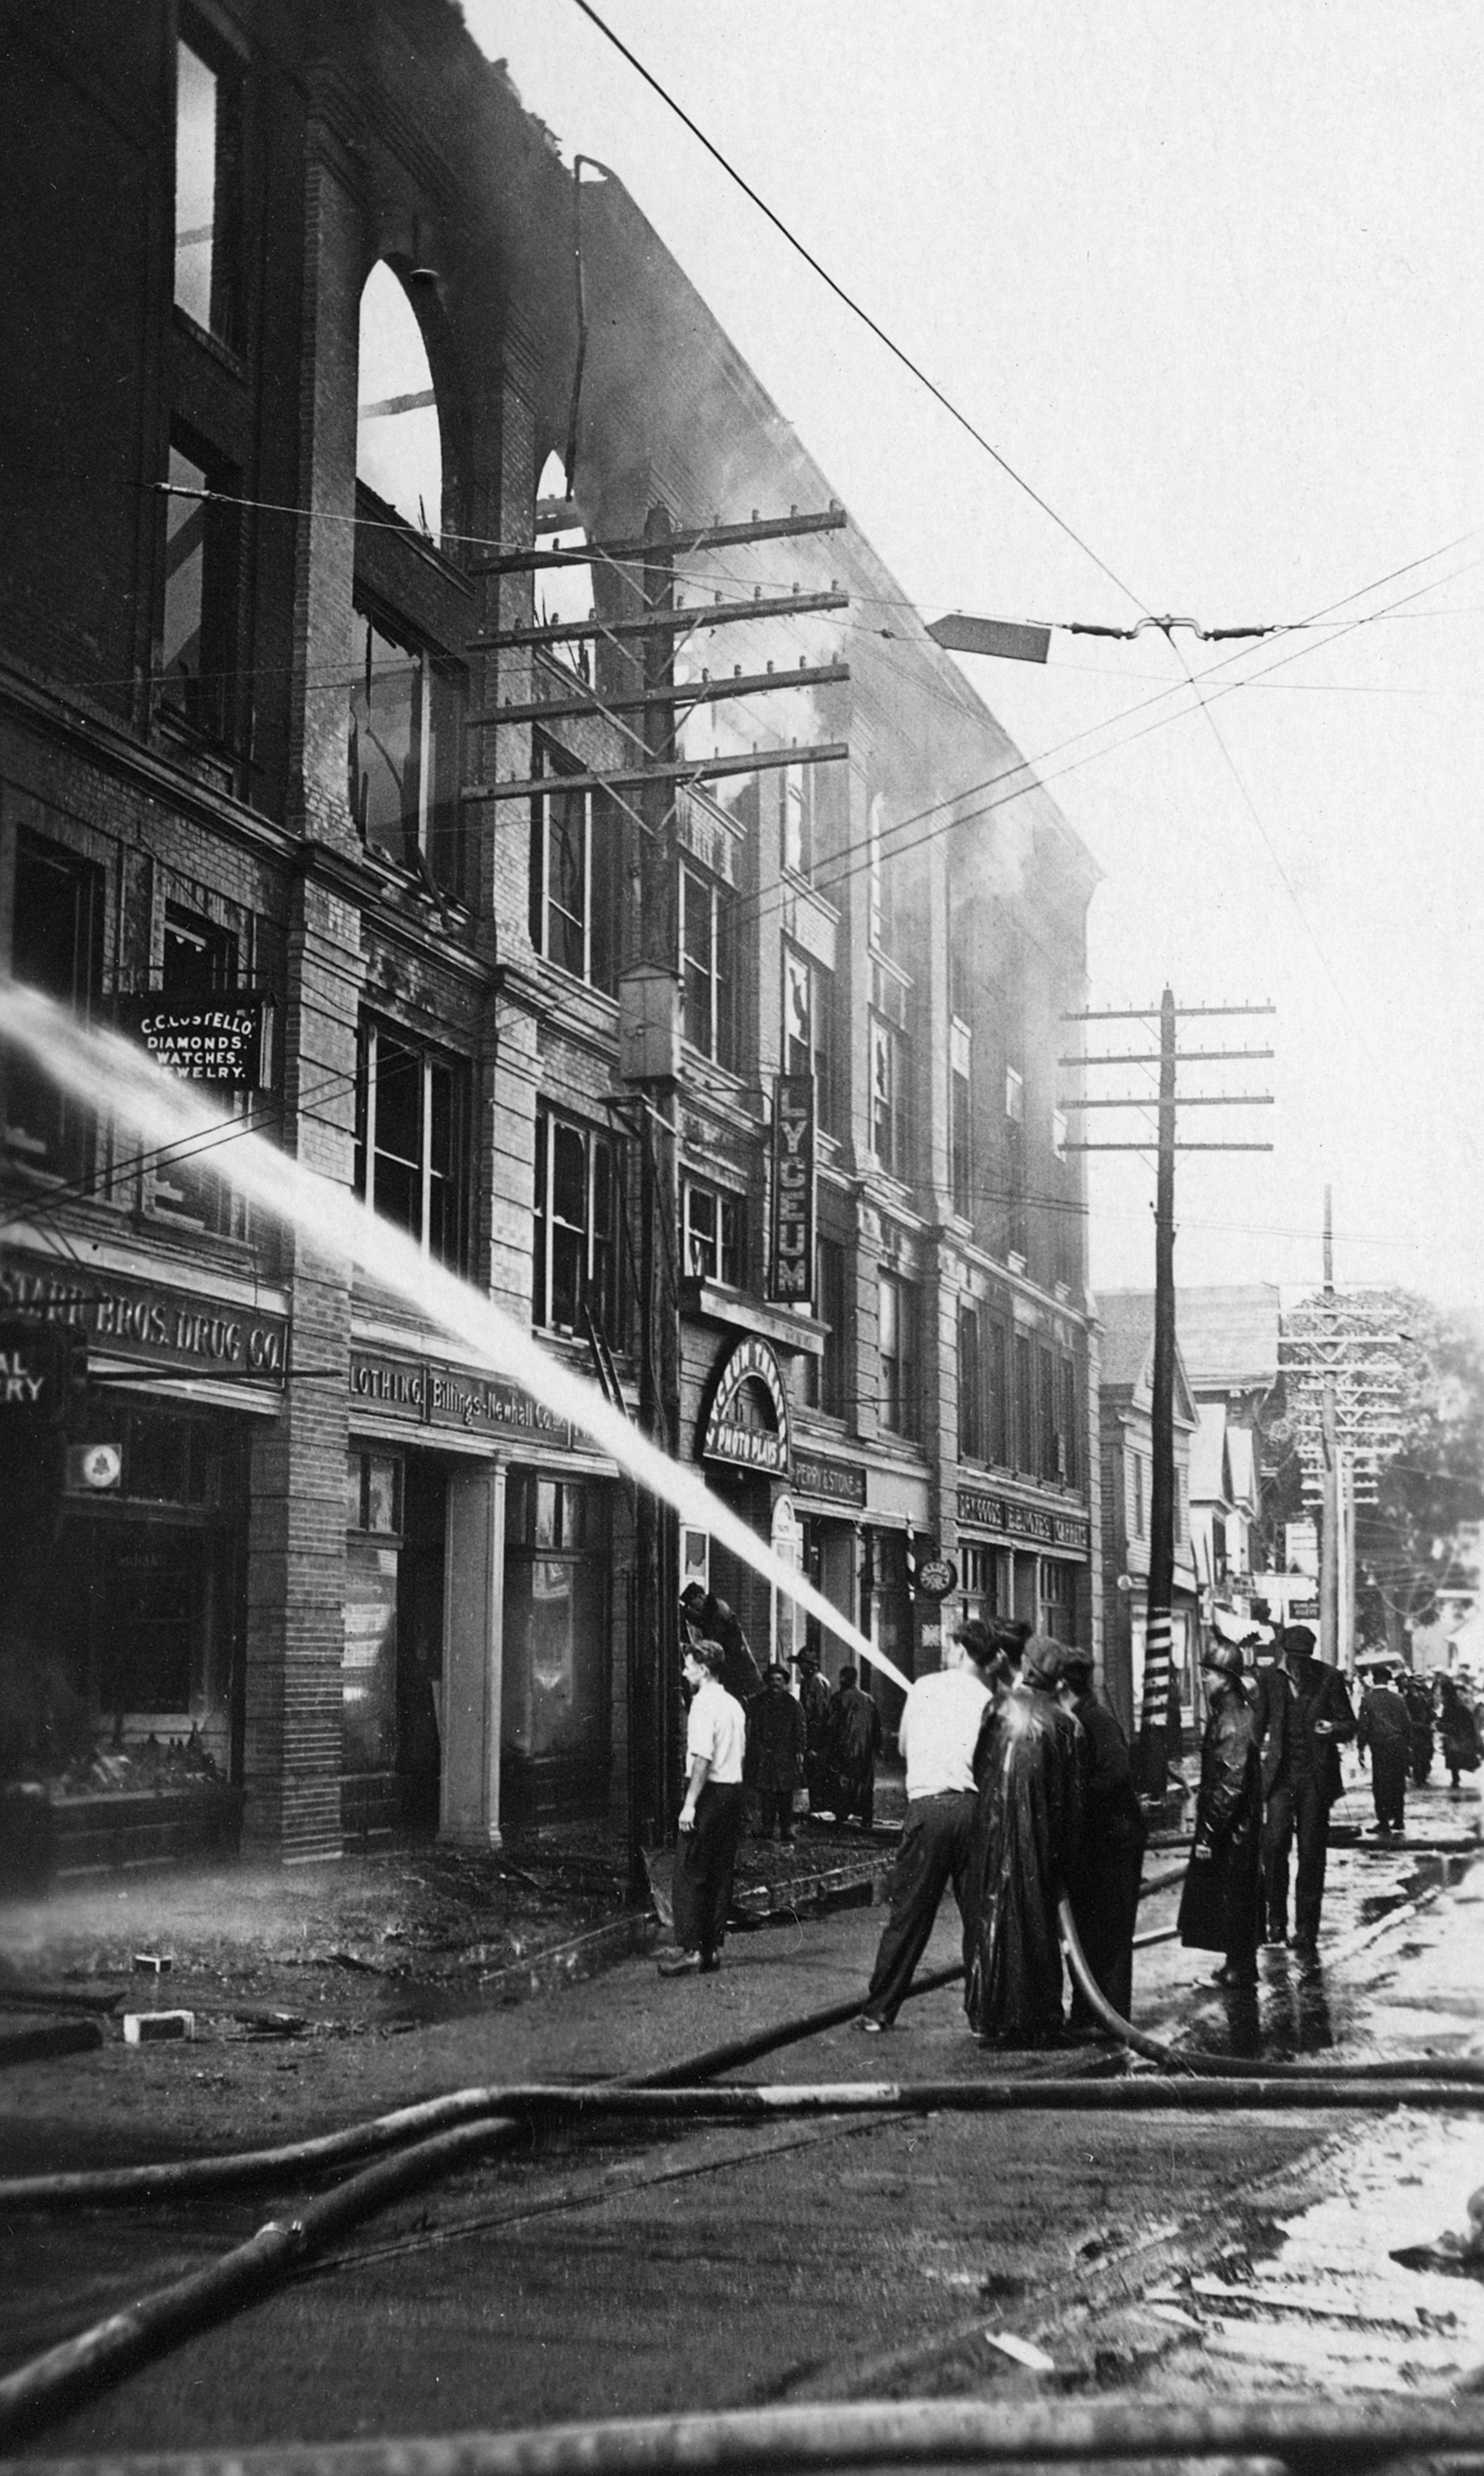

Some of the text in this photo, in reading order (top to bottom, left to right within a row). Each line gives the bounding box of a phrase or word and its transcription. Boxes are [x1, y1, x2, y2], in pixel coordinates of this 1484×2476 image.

[150, 1067, 246, 1078] EWELRY.
[779, 1087, 808, 1291] LYCEUM
[97, 1292, 170, 1345] BROS.
[177, 1309, 241, 1361] DRUG
